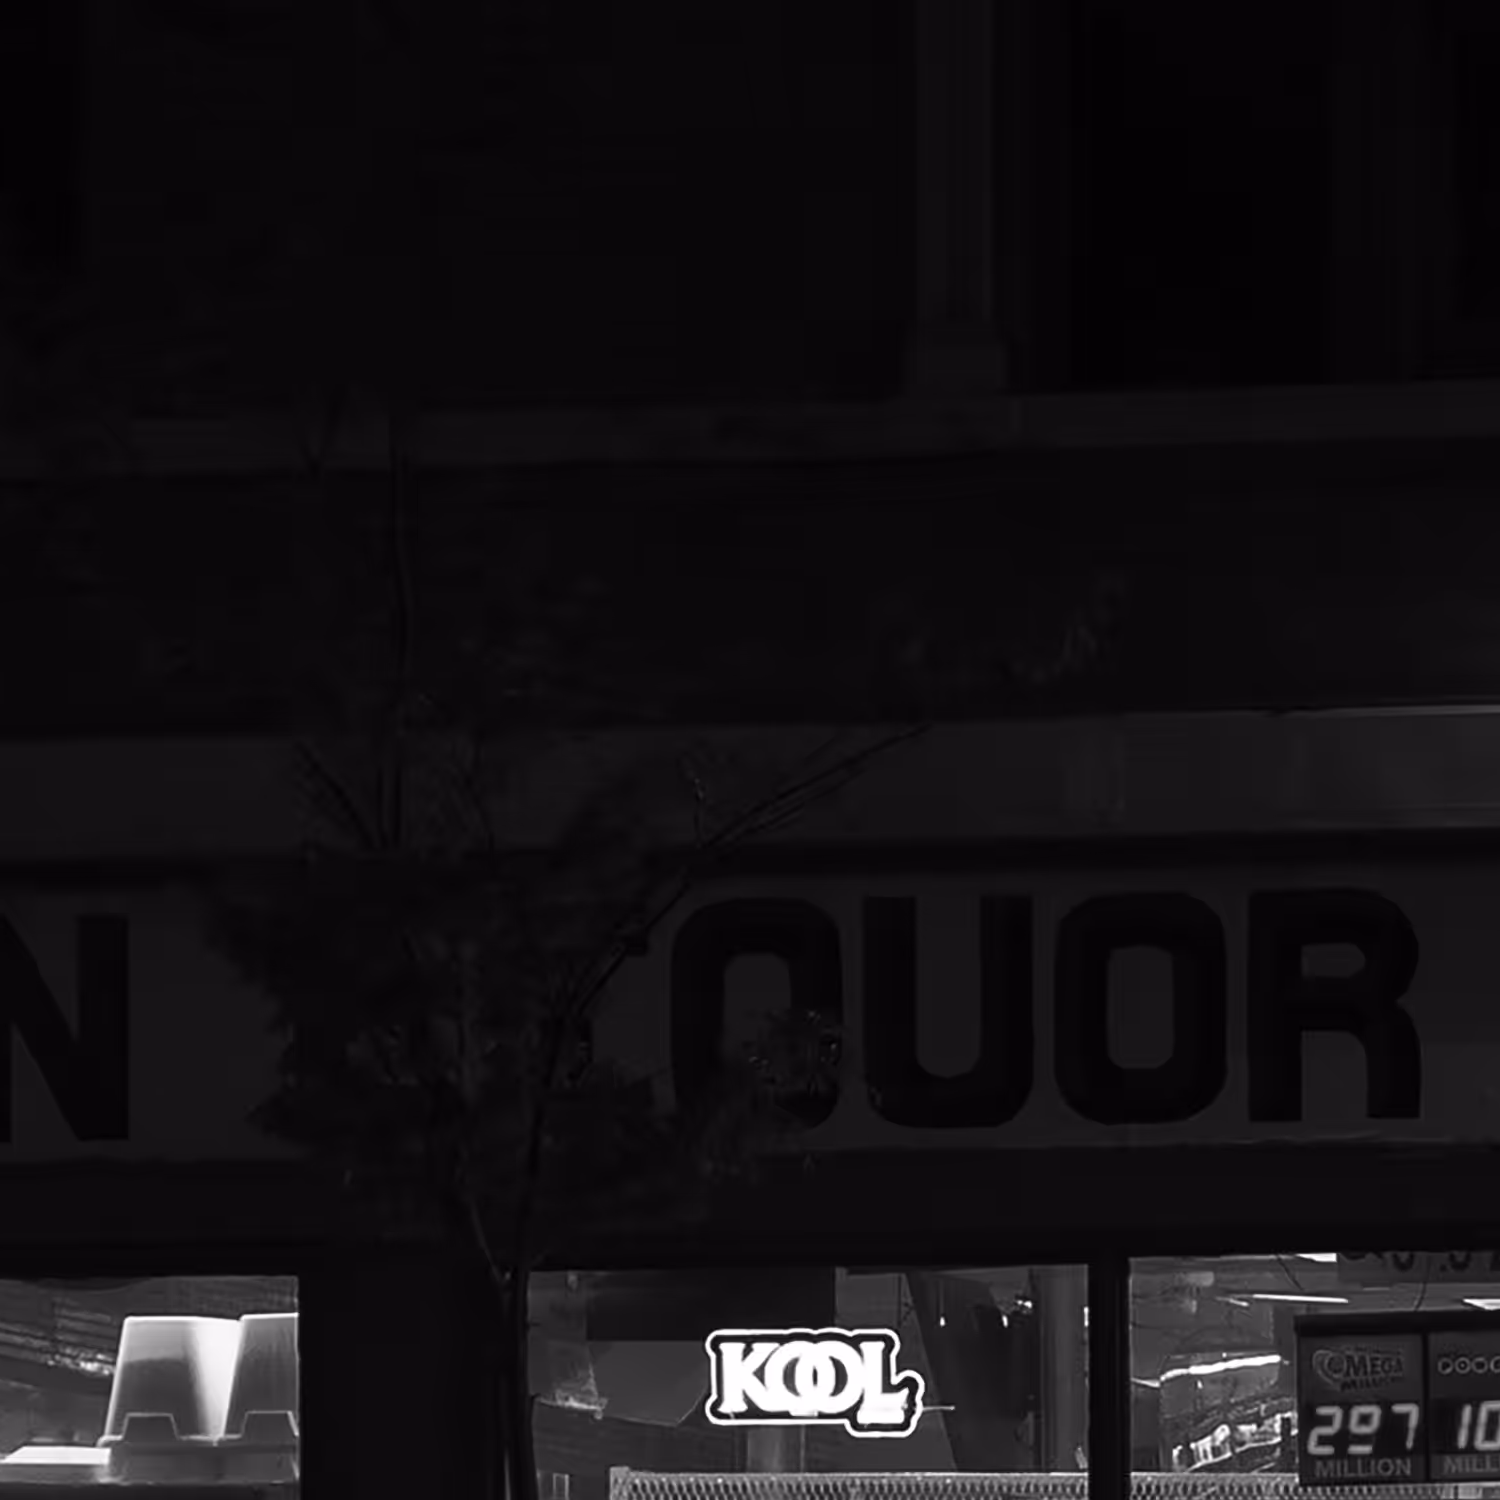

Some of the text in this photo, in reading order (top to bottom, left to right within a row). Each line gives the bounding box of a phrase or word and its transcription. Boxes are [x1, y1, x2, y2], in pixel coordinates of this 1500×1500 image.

[670, 890, 1422, 1128] QUOR
[717, 1341, 910, 1425] KOOL
[1307, 1402, 1419, 1456] 297
[1315, 1457, 1413, 1479] MILLION
